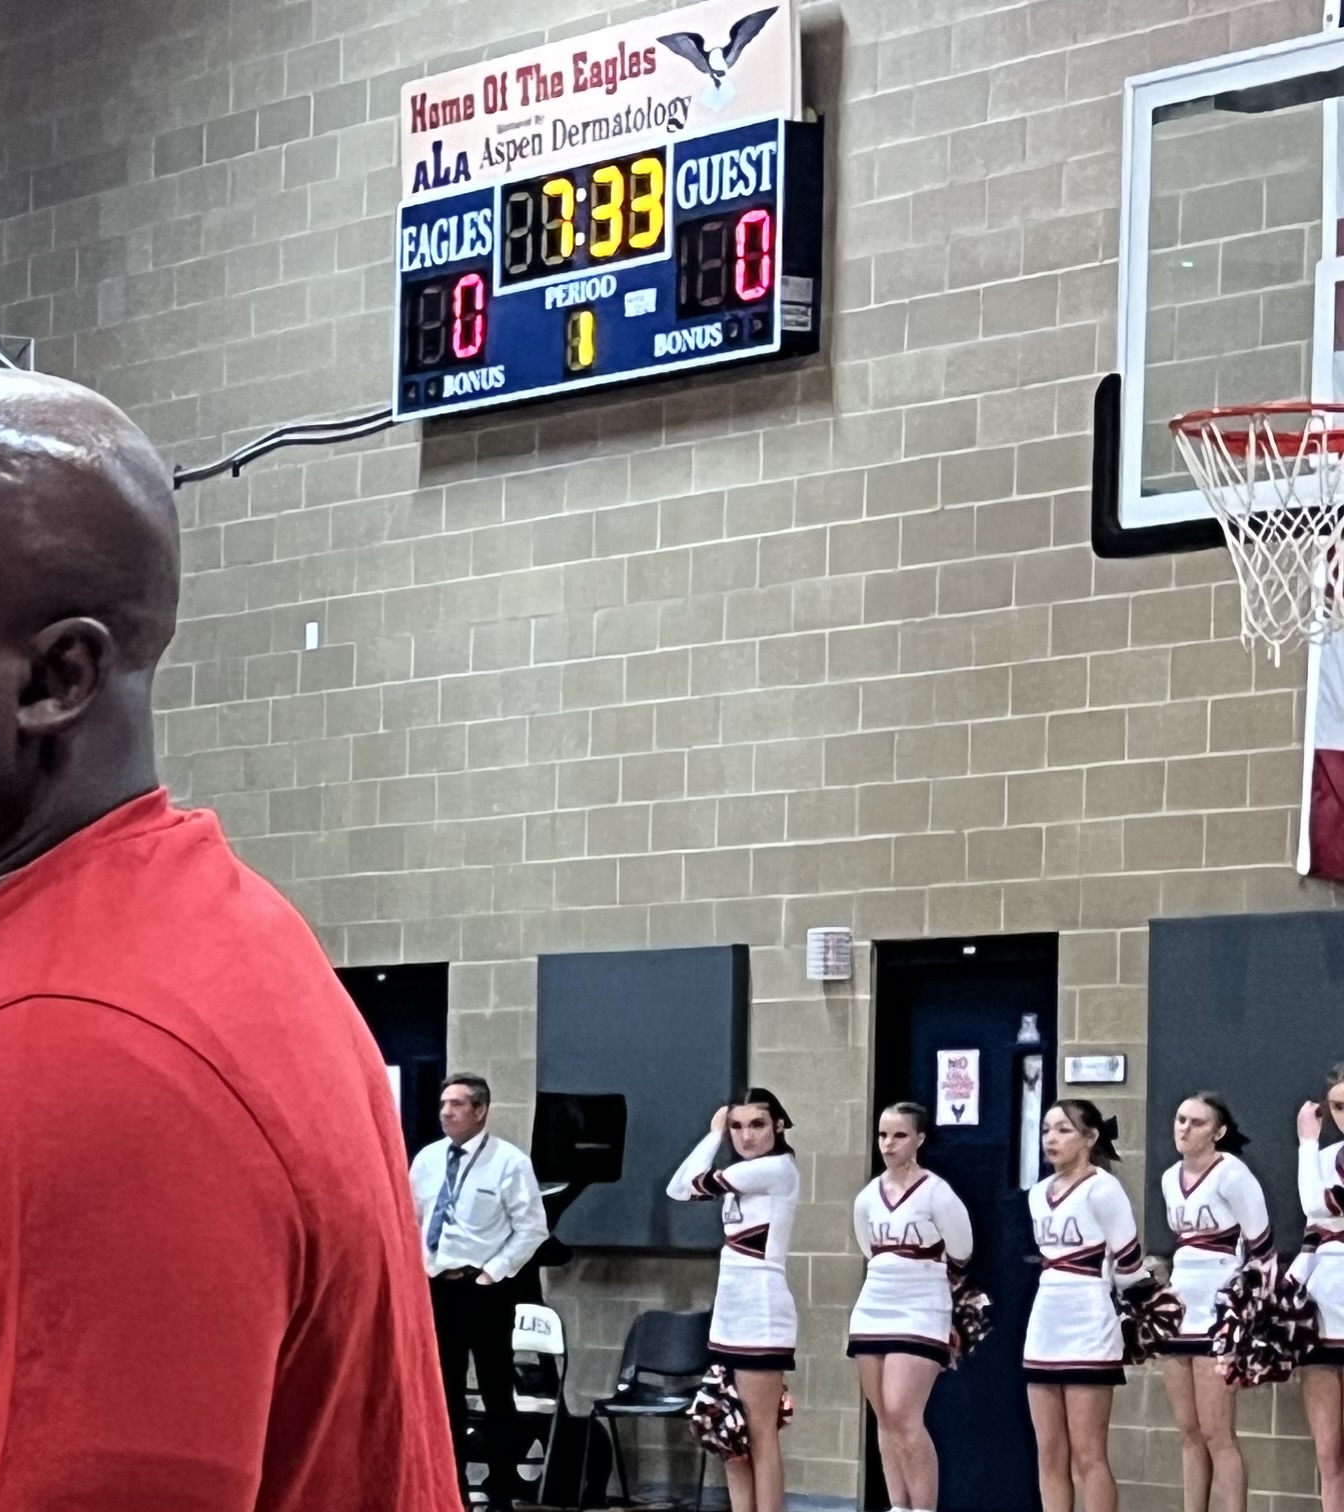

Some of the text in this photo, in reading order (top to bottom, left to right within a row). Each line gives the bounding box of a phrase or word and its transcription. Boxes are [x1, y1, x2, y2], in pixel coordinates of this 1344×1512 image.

[411, 92, 475, 134] Home
[483, 71, 509, 114] Of
[516, 63, 565, 107] The
[573, 41, 657, 95] Eagles
[412, 140, 472, 193] ALA
[479, 95, 692, 173] Aspen Dermatology
[542, 156, 665, 260] 7:33
[676, 141, 778, 210] GUEST
[401, 208, 493, 272] EAGLES
[735, 209, 771, 301] 0
[452, 273, 484, 358] 0
[545, 274, 618, 310] PERIOD
[578, 310, 595, 367] 1
[654, 322, 723, 357] BONUS
[442, 365, 506, 398] BONUS
